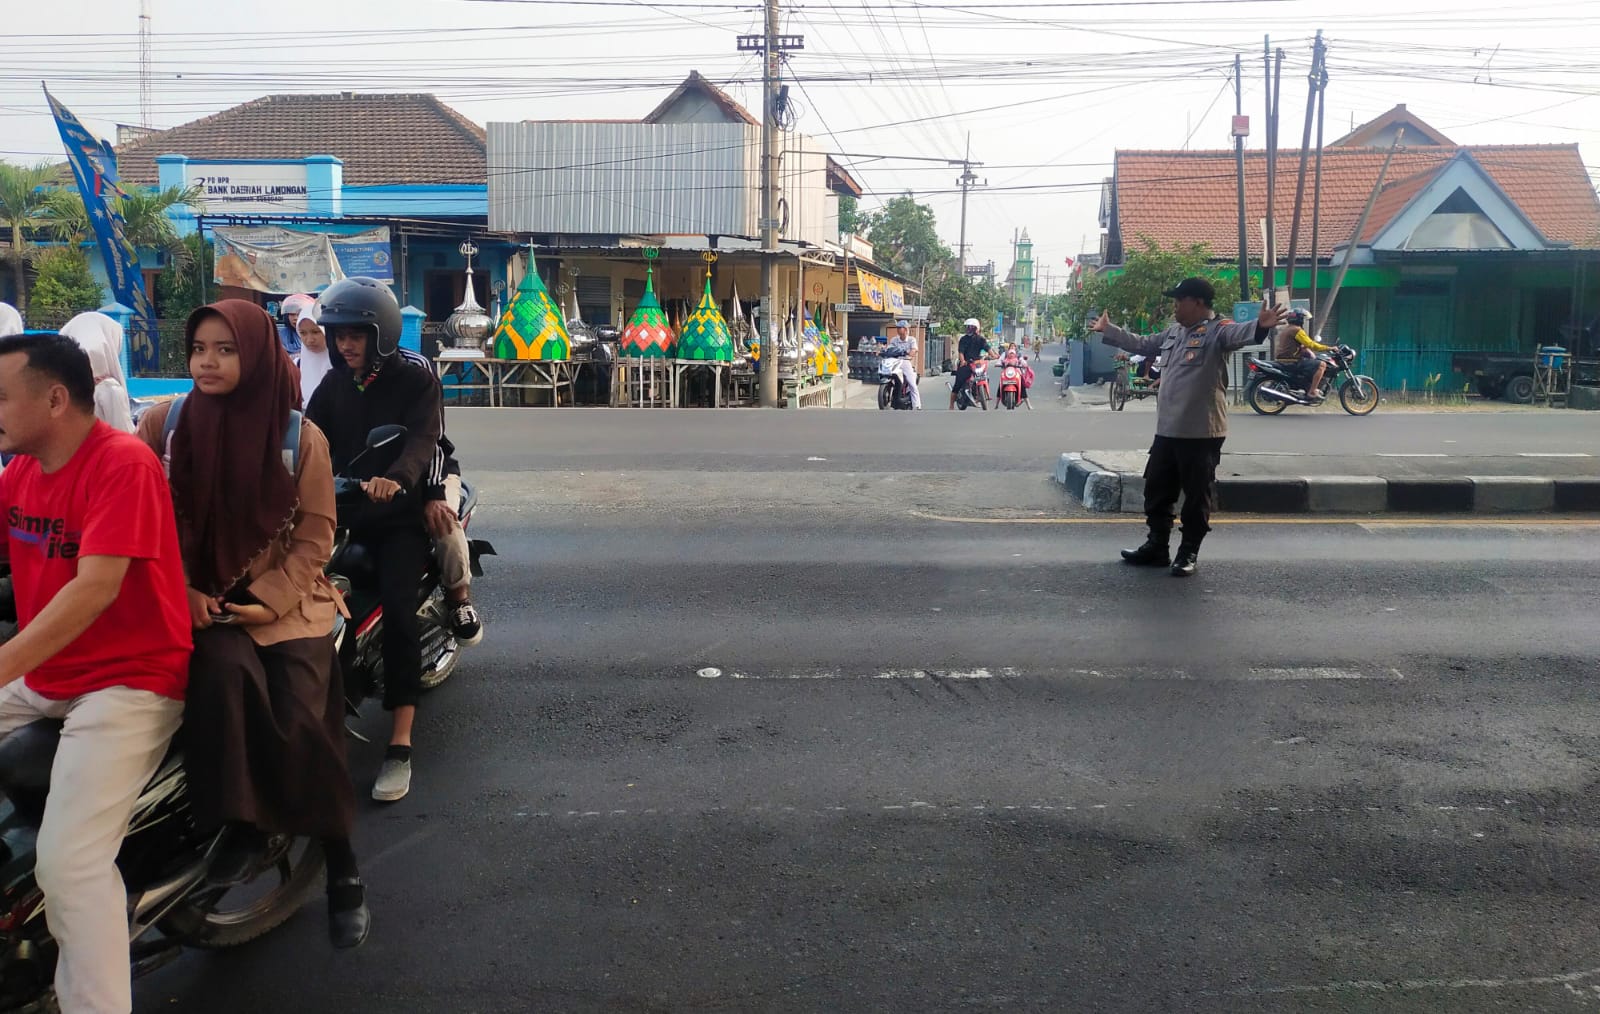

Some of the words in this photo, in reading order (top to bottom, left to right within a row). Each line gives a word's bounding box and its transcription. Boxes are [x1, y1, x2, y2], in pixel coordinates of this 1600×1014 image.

[207, 185, 228, 195] BANK
[230, 185, 262, 195] DAERAH
[264, 185, 307, 195] LAMONGAN
